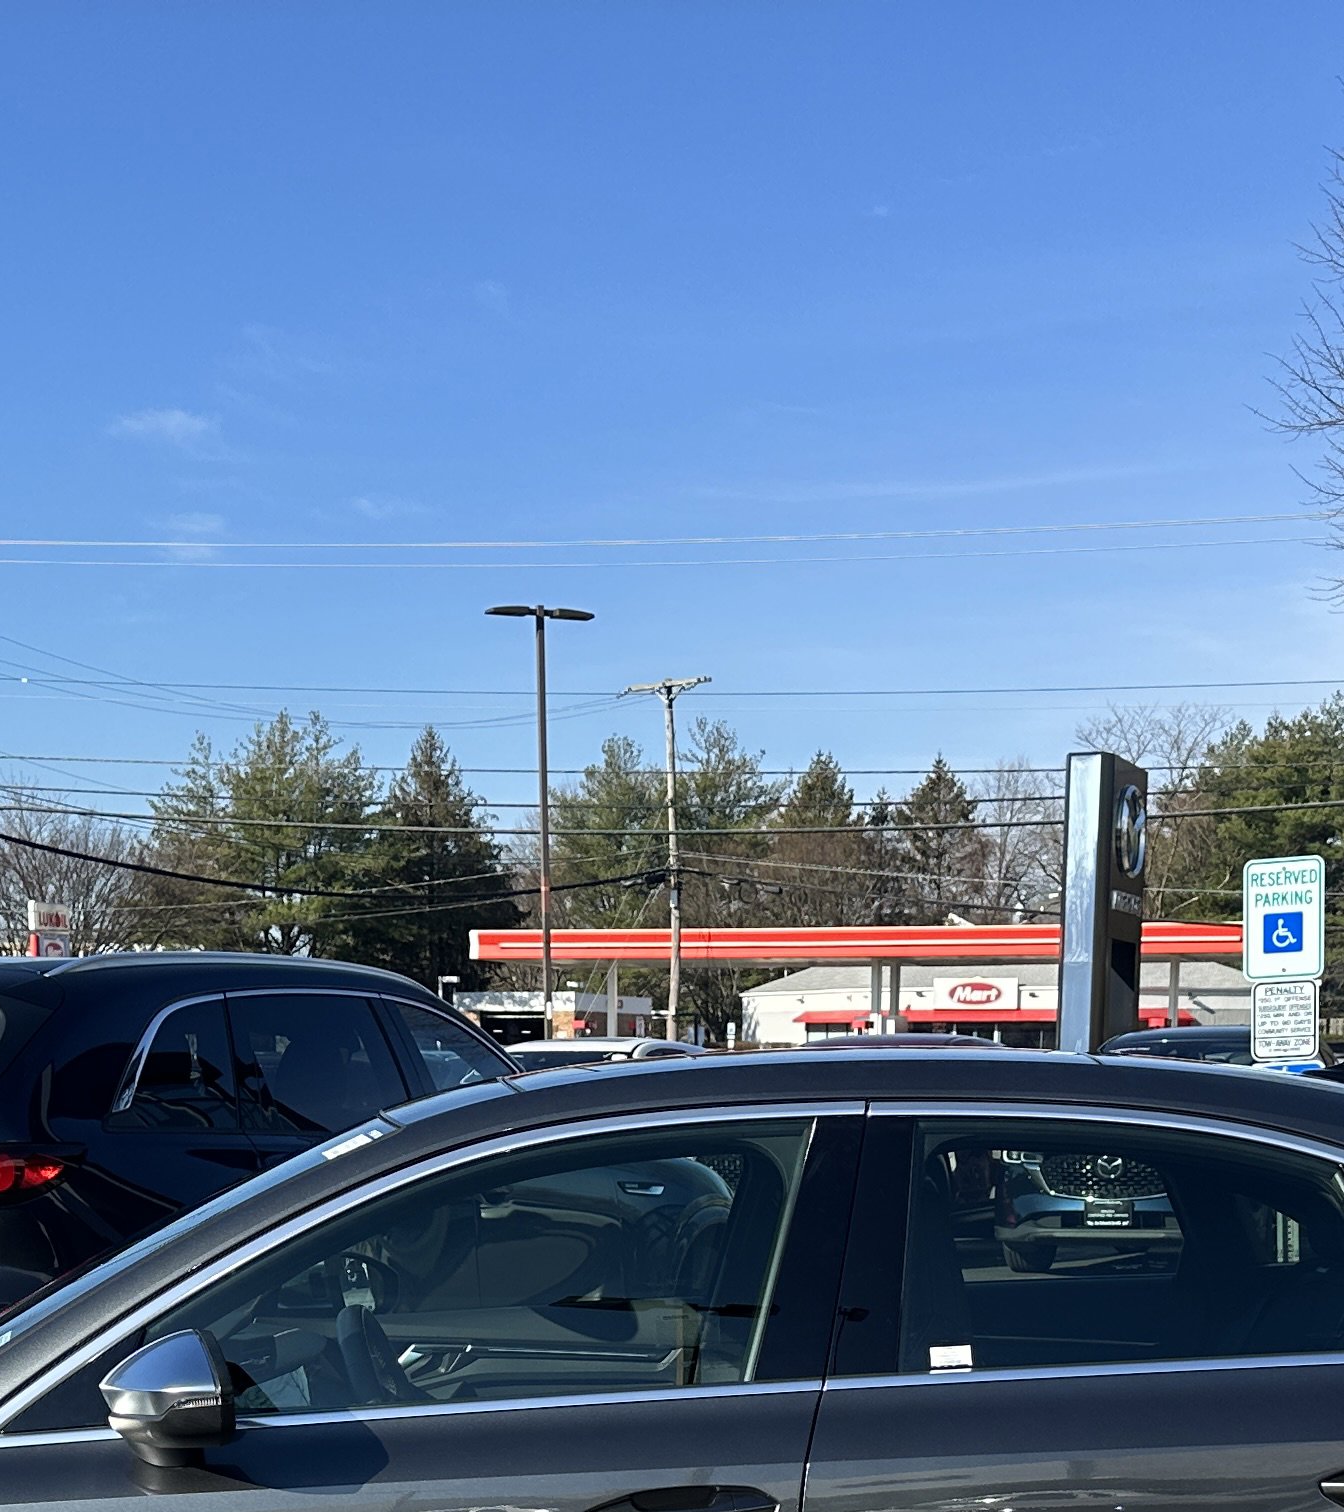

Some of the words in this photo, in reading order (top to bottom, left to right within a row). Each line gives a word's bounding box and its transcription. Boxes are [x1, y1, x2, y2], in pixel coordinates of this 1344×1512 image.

[1251, 869, 1317, 887] RESERVED
[1255, 889, 1312, 907] PARKING
[953, 986, 998, 1003] Mart
